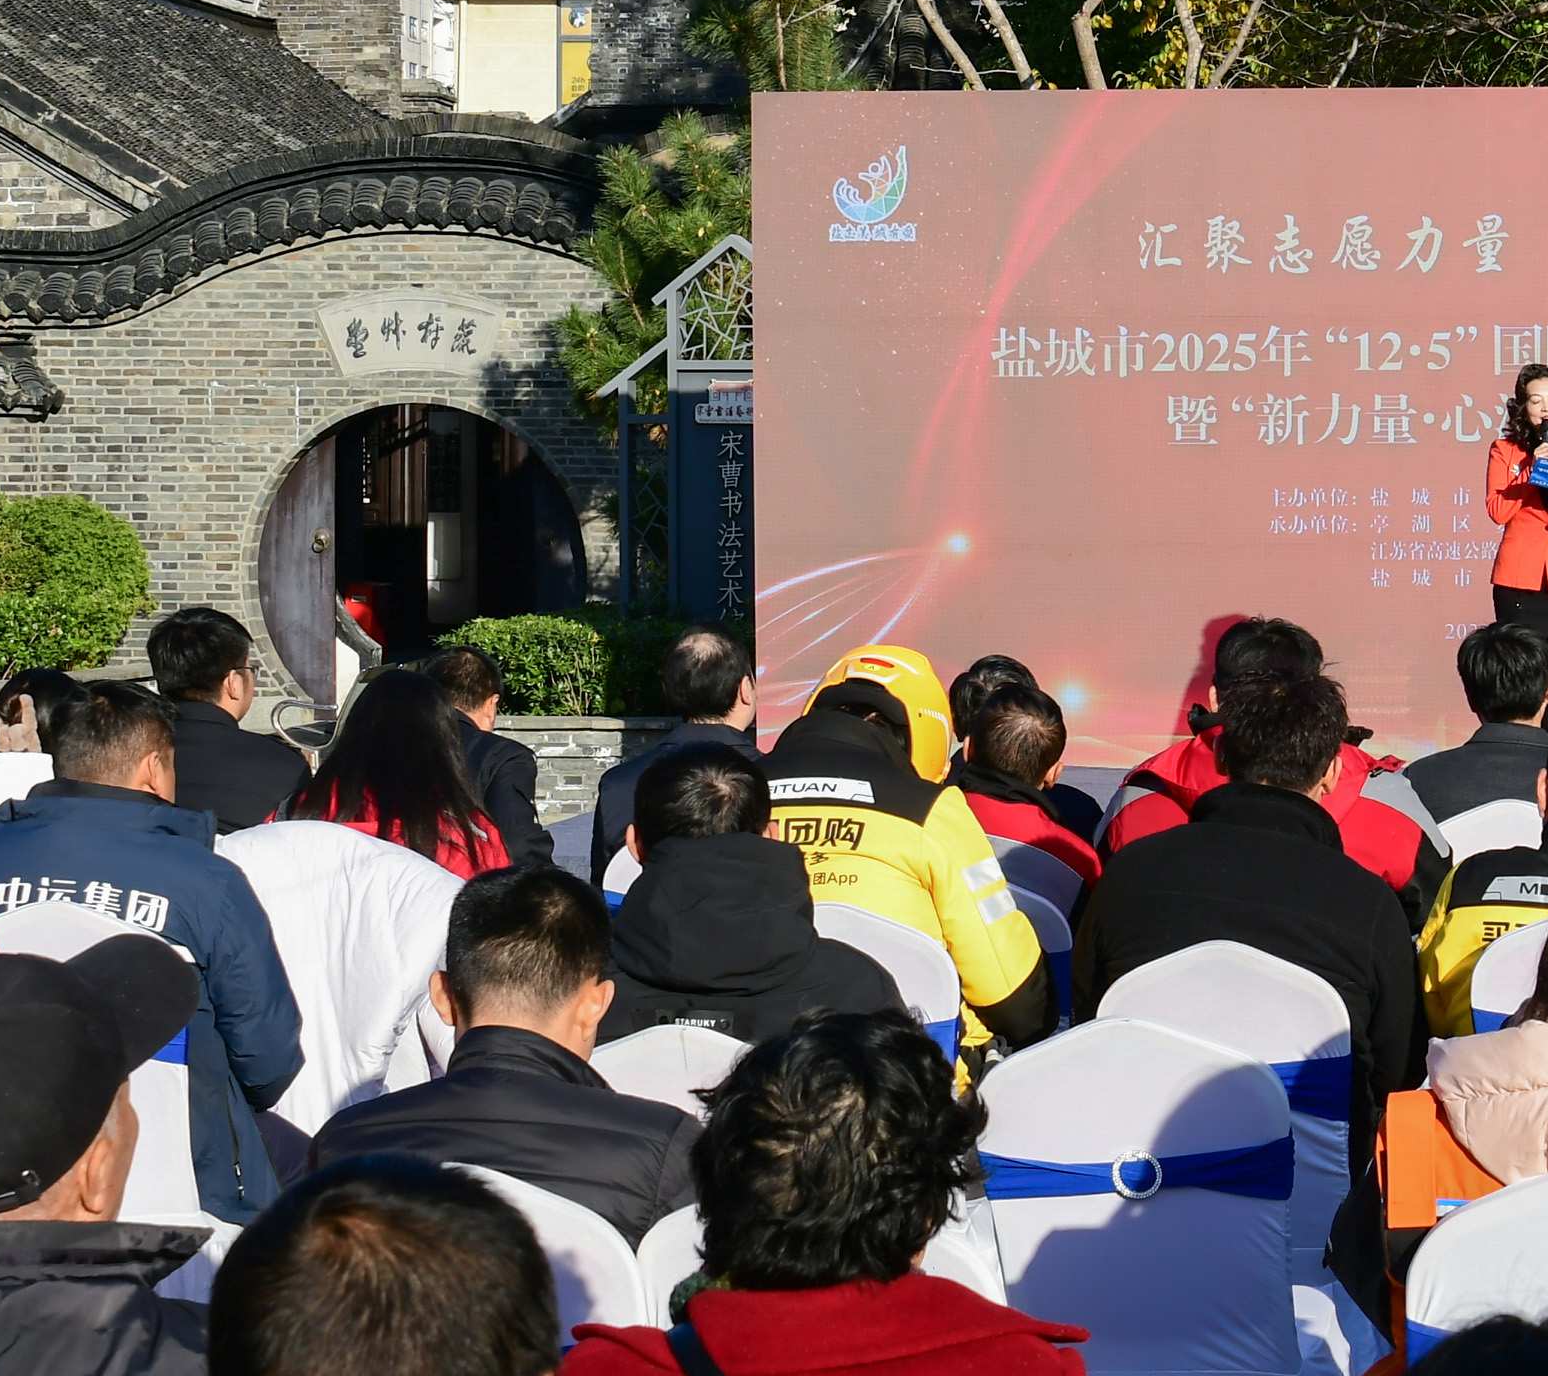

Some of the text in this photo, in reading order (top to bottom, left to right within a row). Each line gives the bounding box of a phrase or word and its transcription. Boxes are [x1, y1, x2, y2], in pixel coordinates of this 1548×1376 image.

[1138, 214, 1509, 275] 汇聚志愿力量
